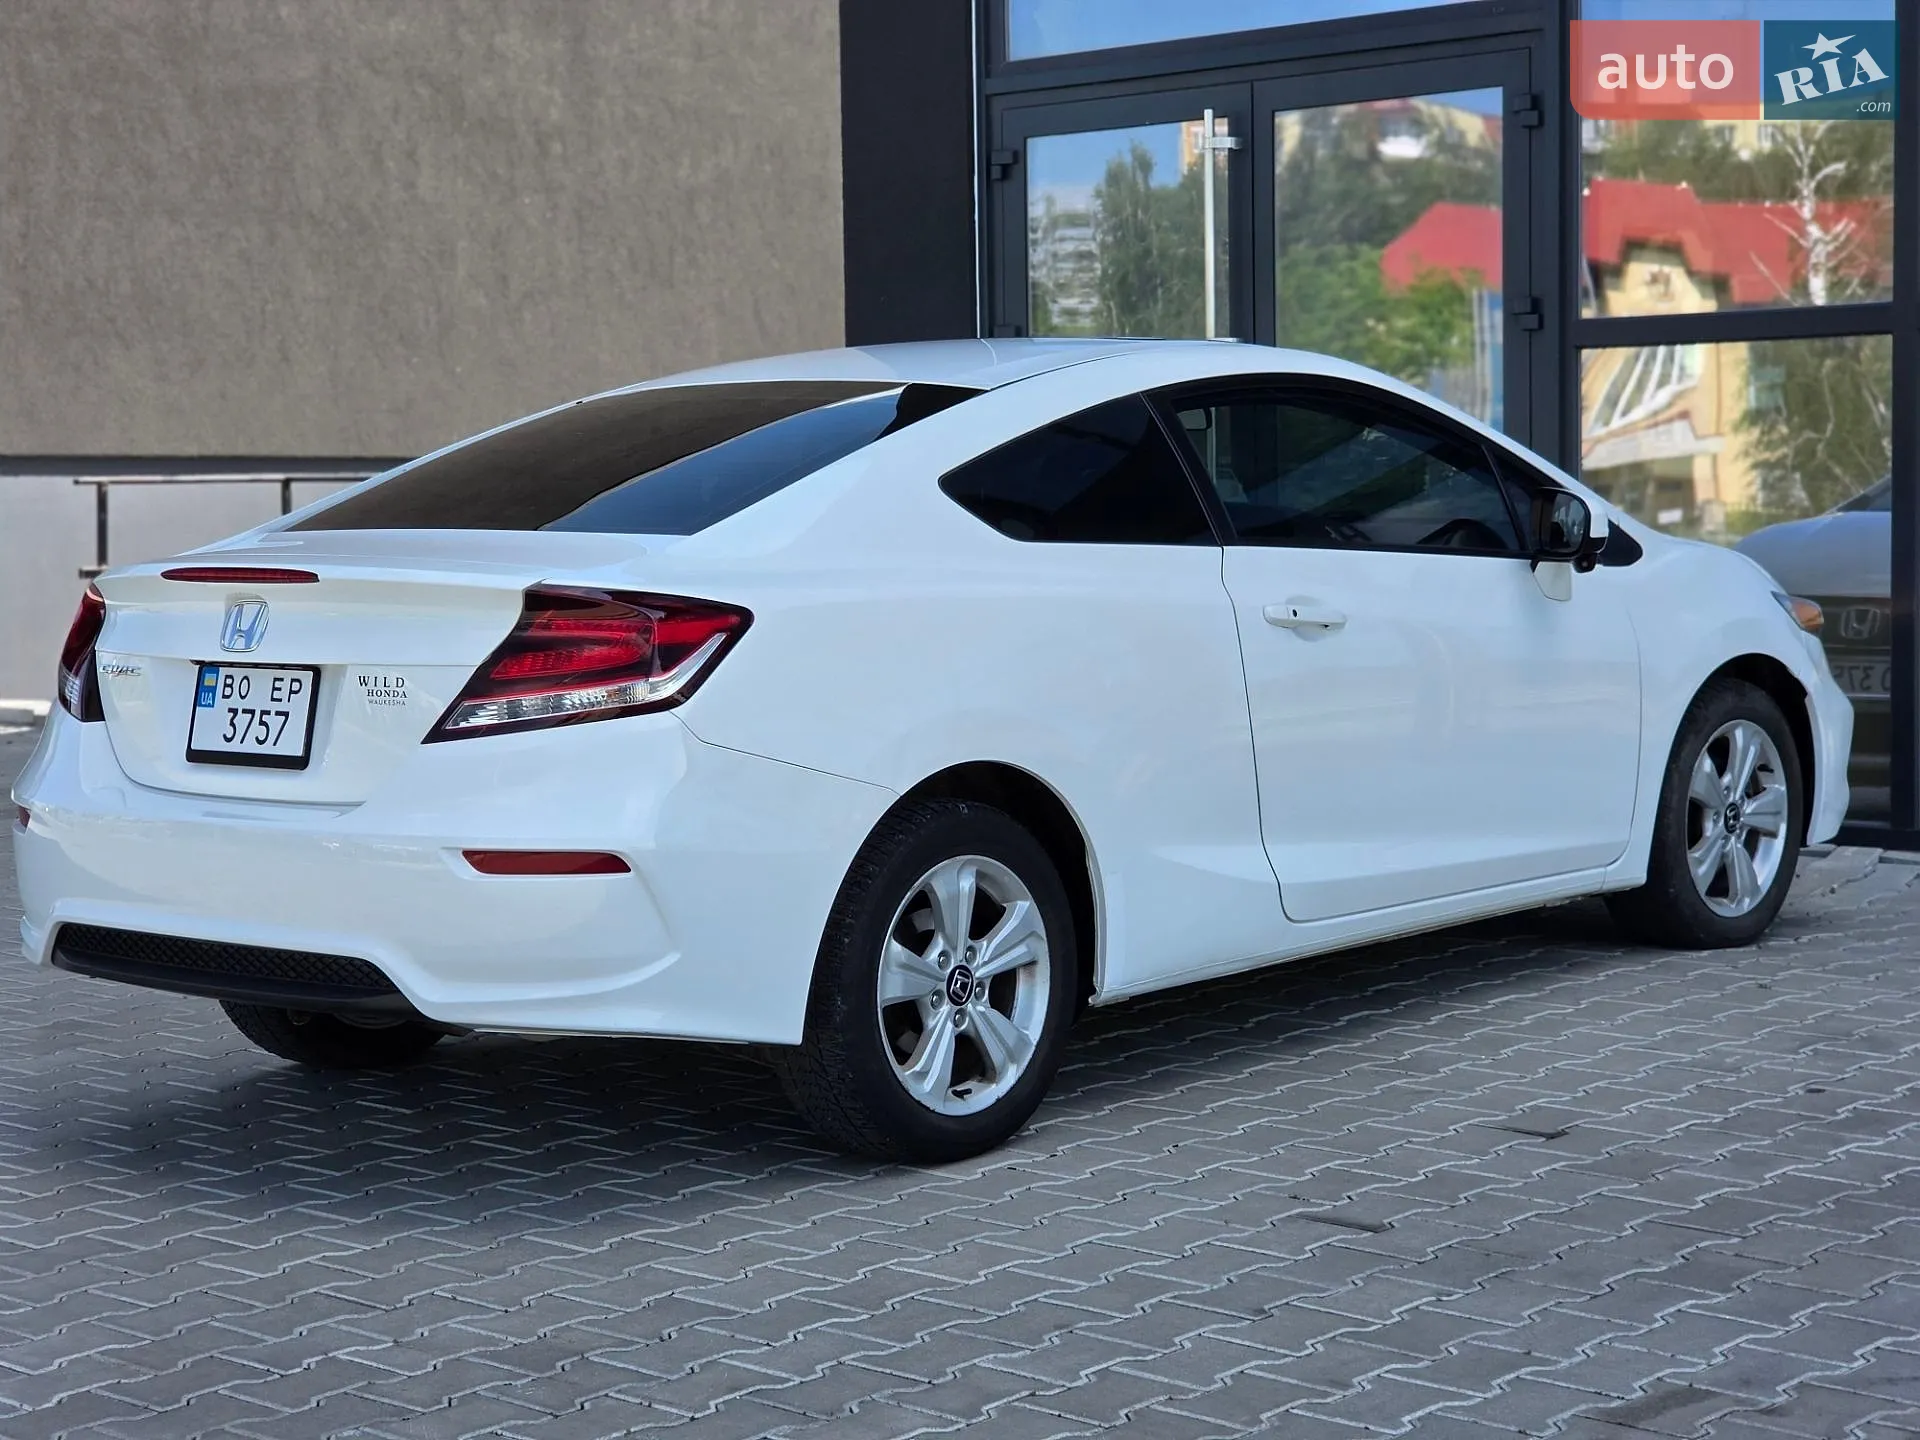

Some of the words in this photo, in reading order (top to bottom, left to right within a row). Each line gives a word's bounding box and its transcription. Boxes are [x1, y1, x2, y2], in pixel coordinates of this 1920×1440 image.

[358, 675, 405, 688] WILD
[221, 674, 251, 700] BO
[270, 677, 303, 703] EP
[367, 689, 408, 698] HONDA
[200, 692, 213, 705] UA
[368, 698, 406, 706] WAUKESHA
[222, 707, 290, 746] 3757
